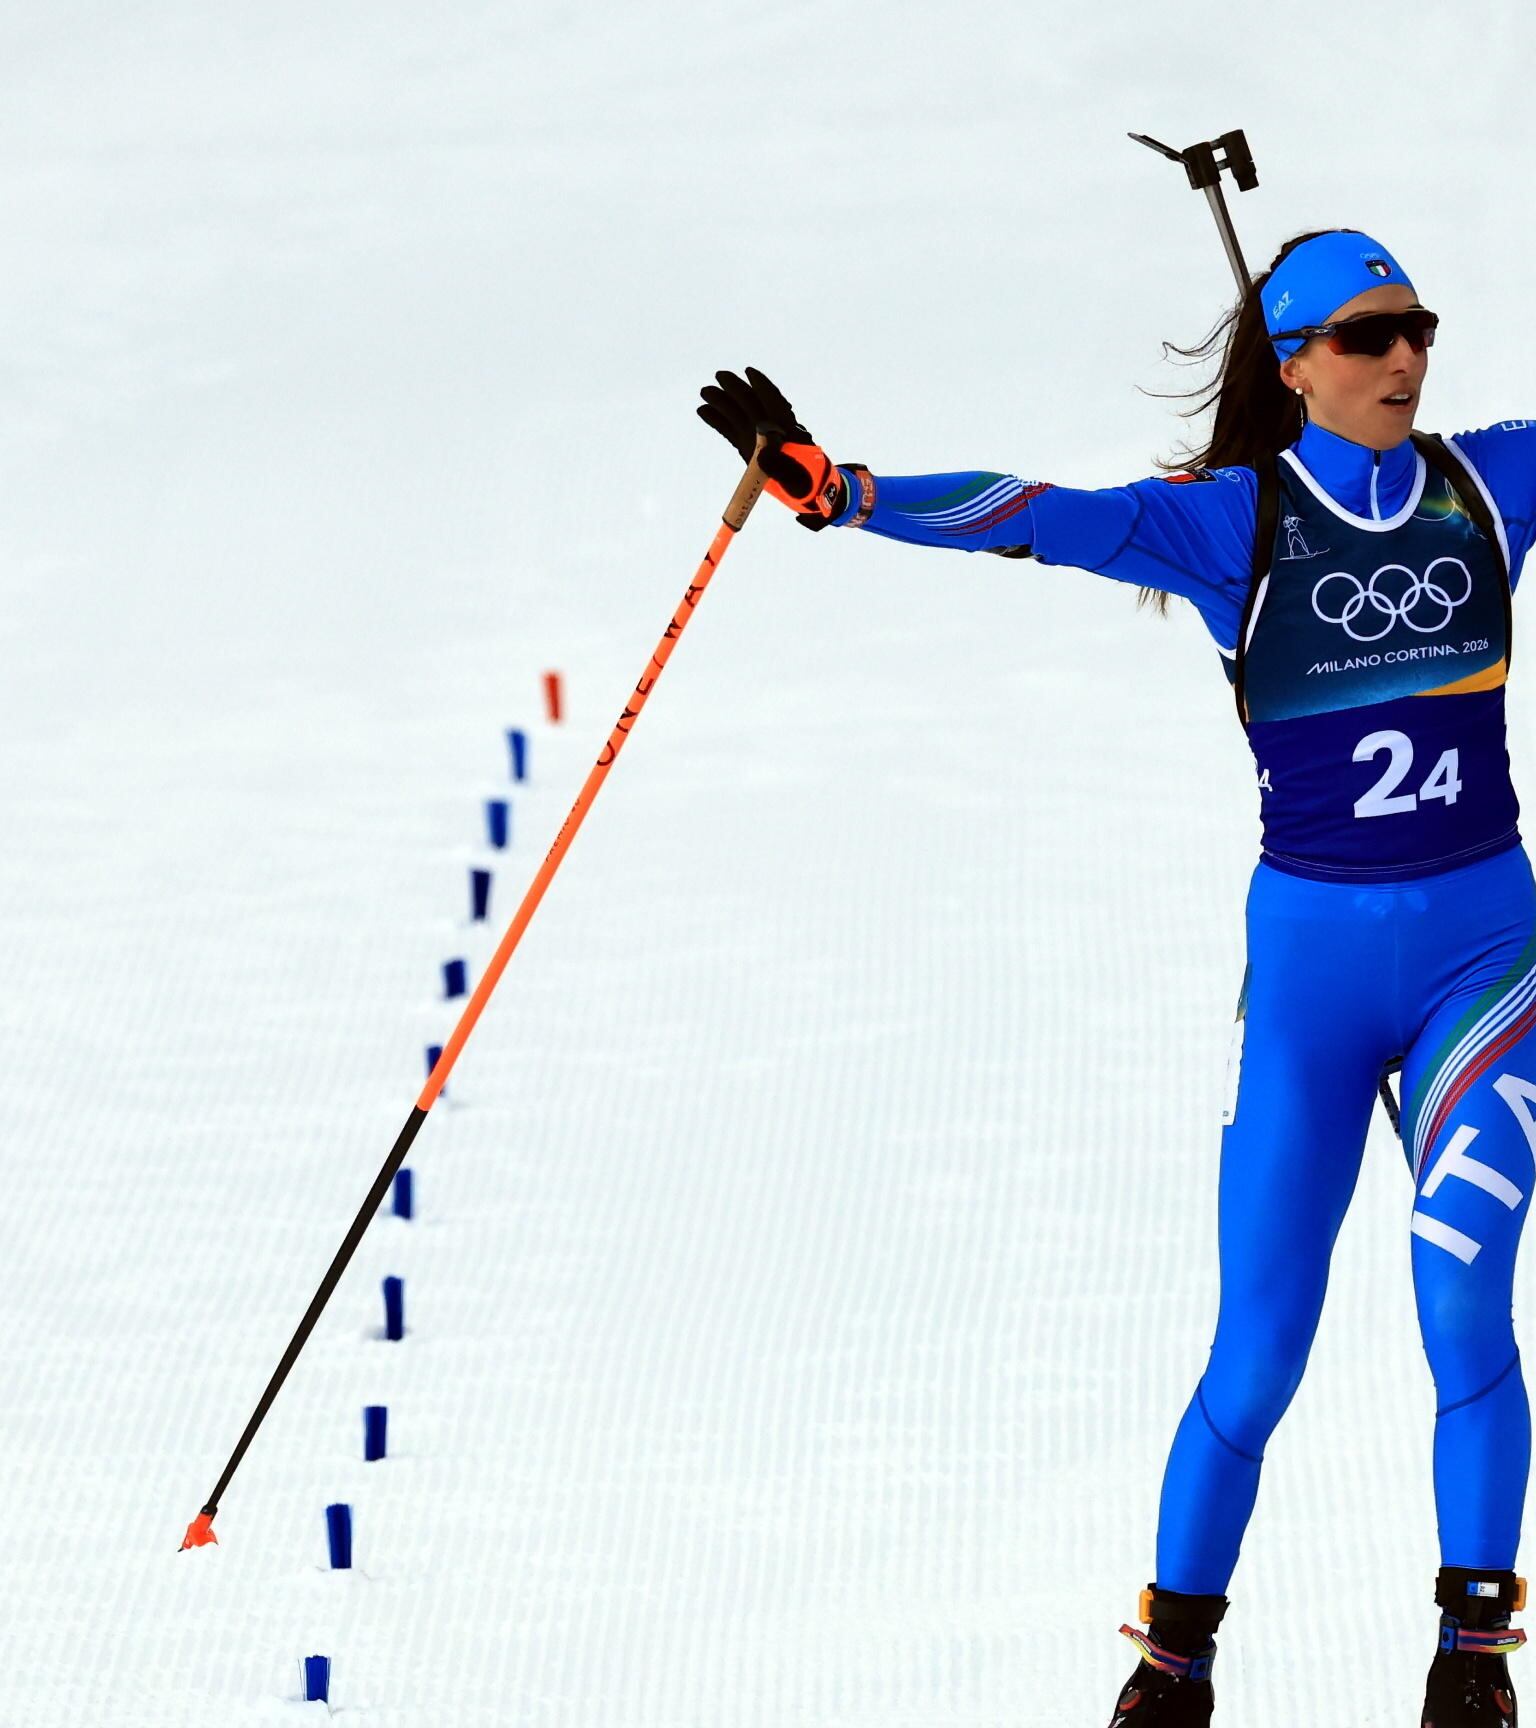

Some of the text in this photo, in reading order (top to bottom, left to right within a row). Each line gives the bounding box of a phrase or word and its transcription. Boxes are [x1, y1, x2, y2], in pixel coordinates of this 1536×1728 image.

[1272, 290, 1294, 320] EA7
[1306, 637, 1489, 675] MILANO CORTINA 2026
[1352, 729, 1463, 819] 24
